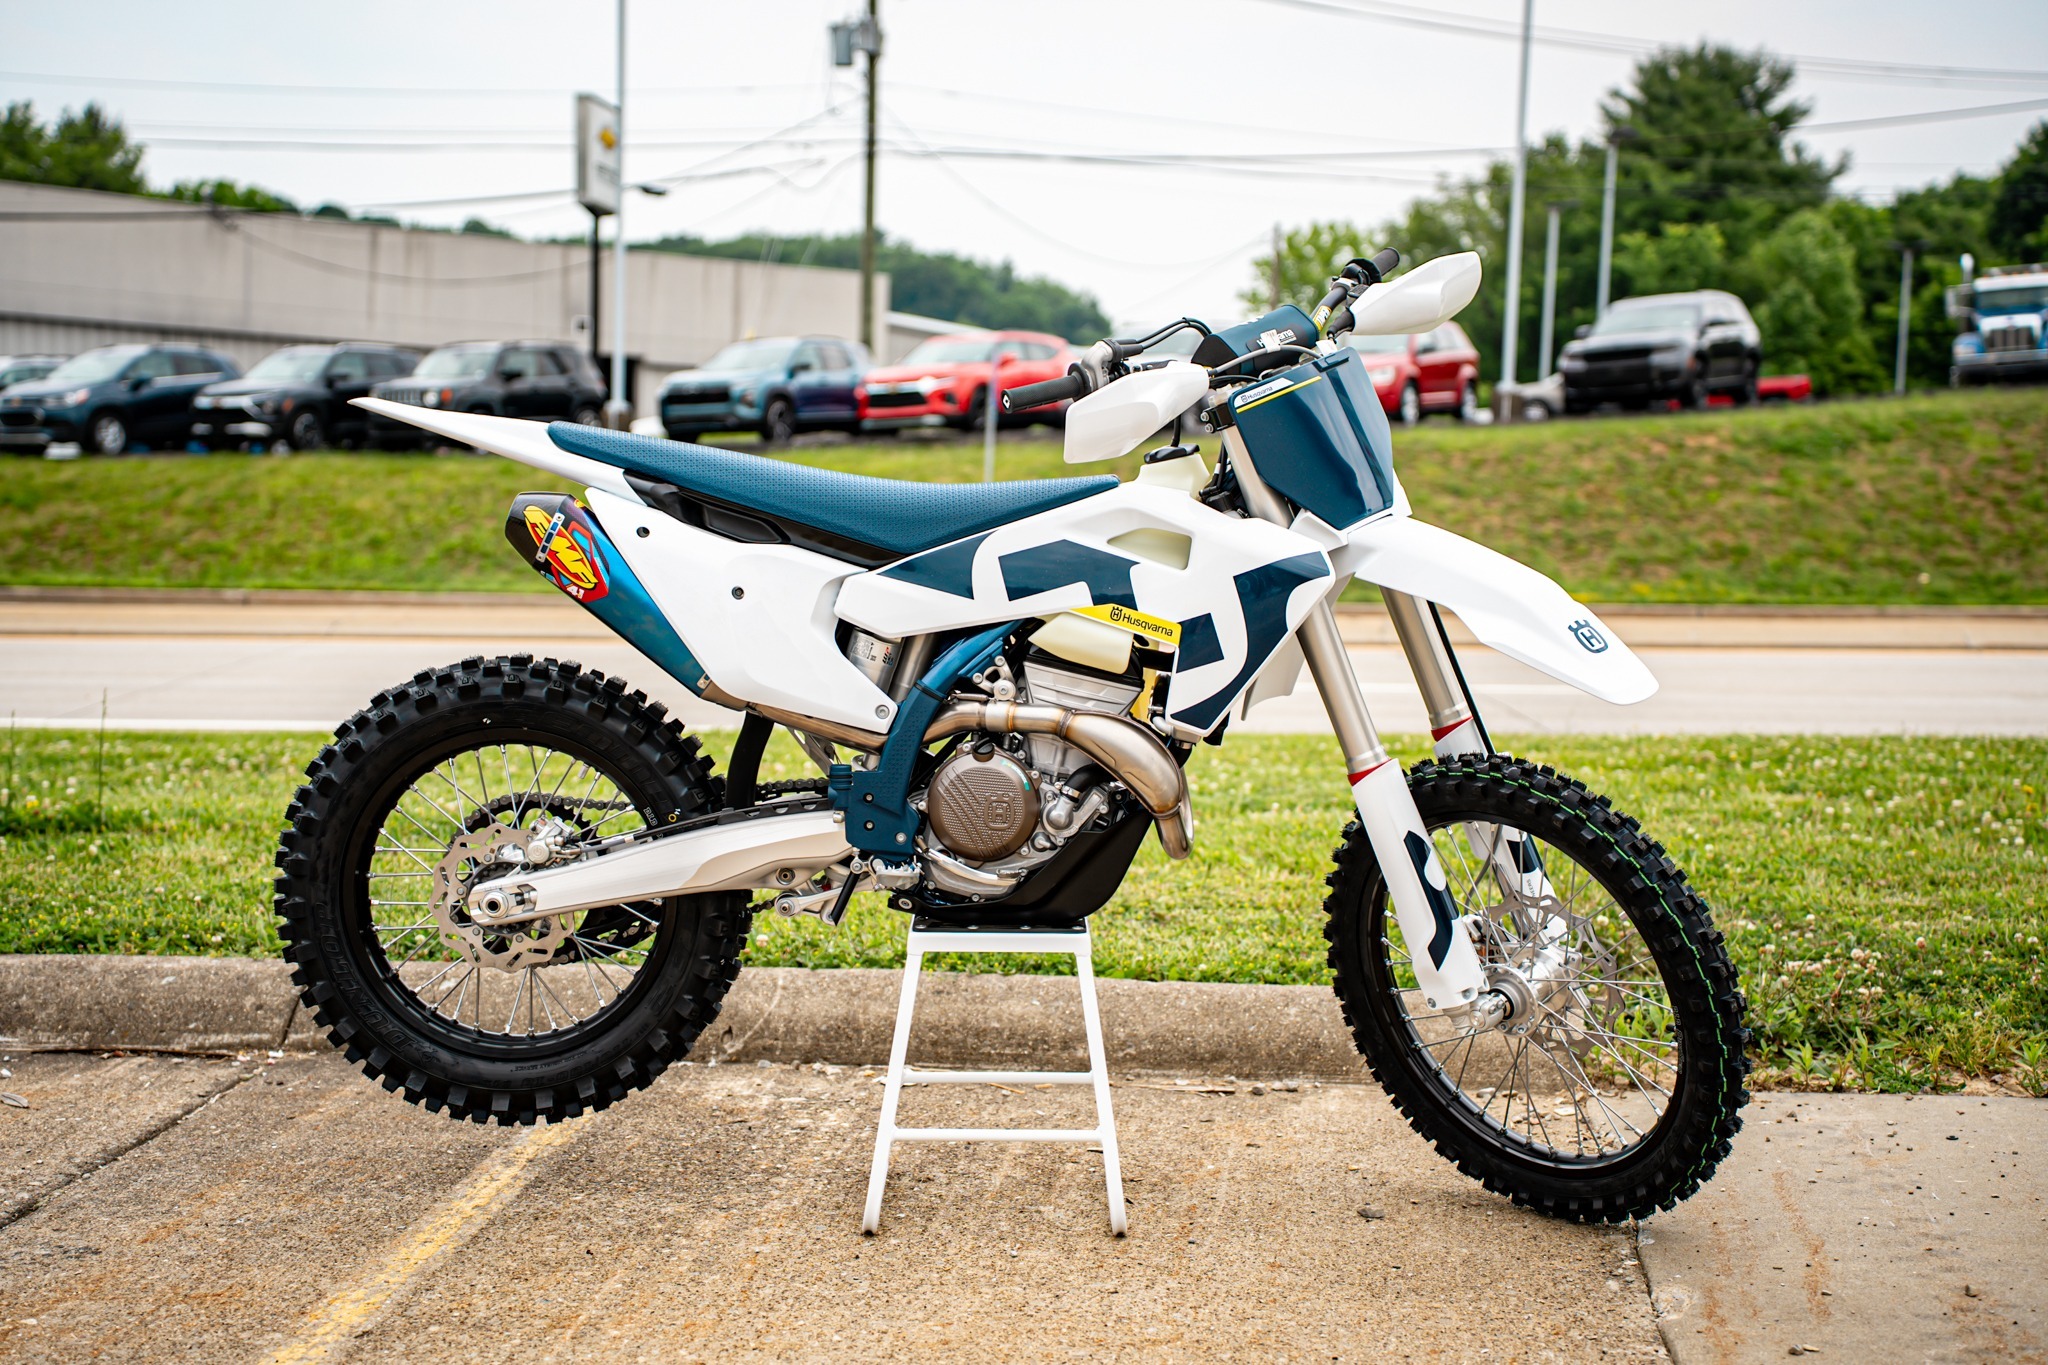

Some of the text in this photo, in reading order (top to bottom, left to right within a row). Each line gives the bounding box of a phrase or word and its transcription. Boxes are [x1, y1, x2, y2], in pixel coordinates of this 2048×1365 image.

[1247, 386, 1273, 400] Husqvarna
[1123, 613, 1173, 637] Husqvarna
[314, 902, 417, 1053] DUNLOP
